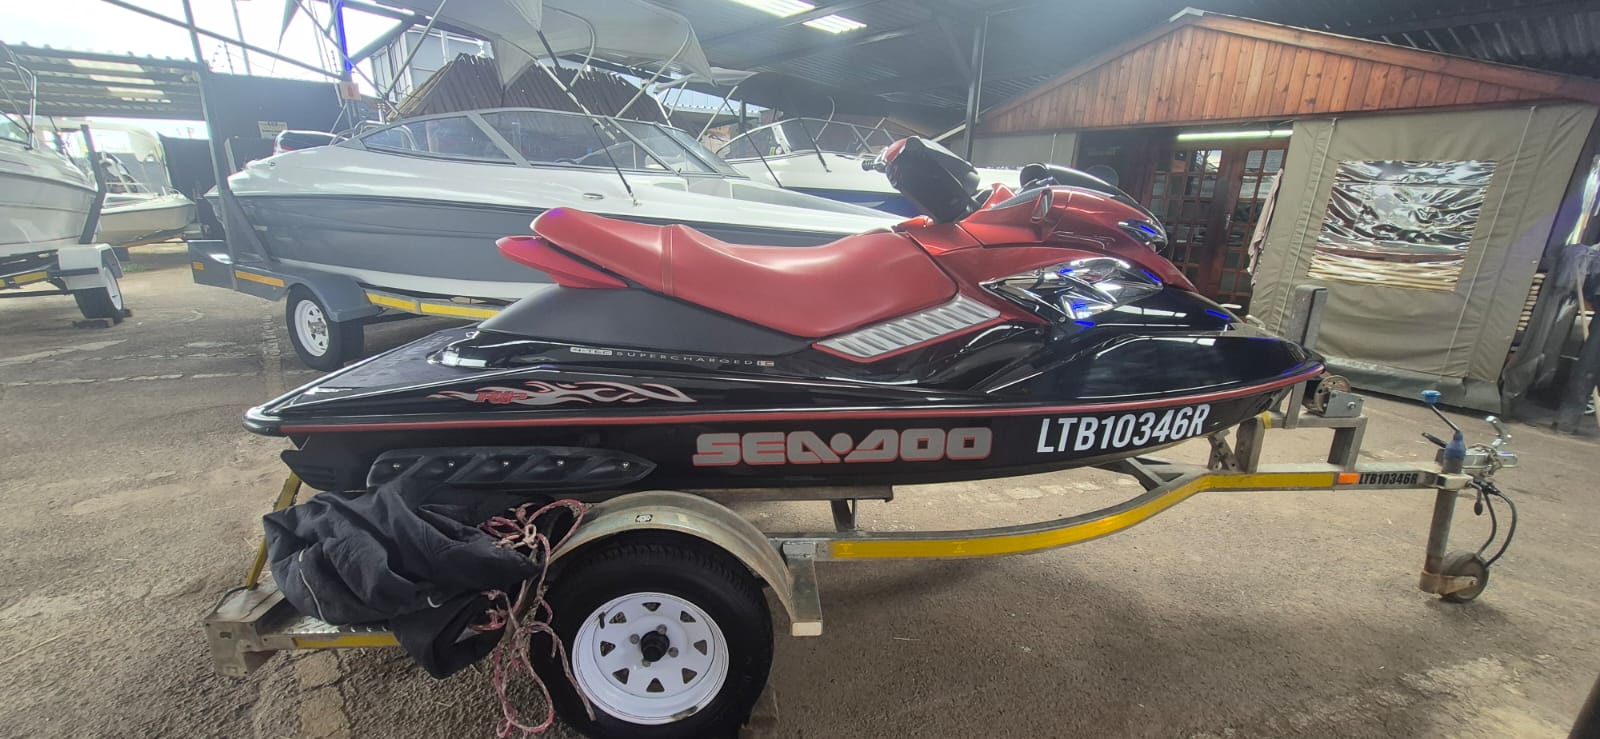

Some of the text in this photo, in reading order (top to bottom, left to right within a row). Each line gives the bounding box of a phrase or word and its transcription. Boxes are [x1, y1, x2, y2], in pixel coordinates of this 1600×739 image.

[616, 351, 753, 365] SUPERCHARGED
[1036, 403, 1211, 453] LTB10346R
[1358, 473, 1418, 485] LTB10346R
